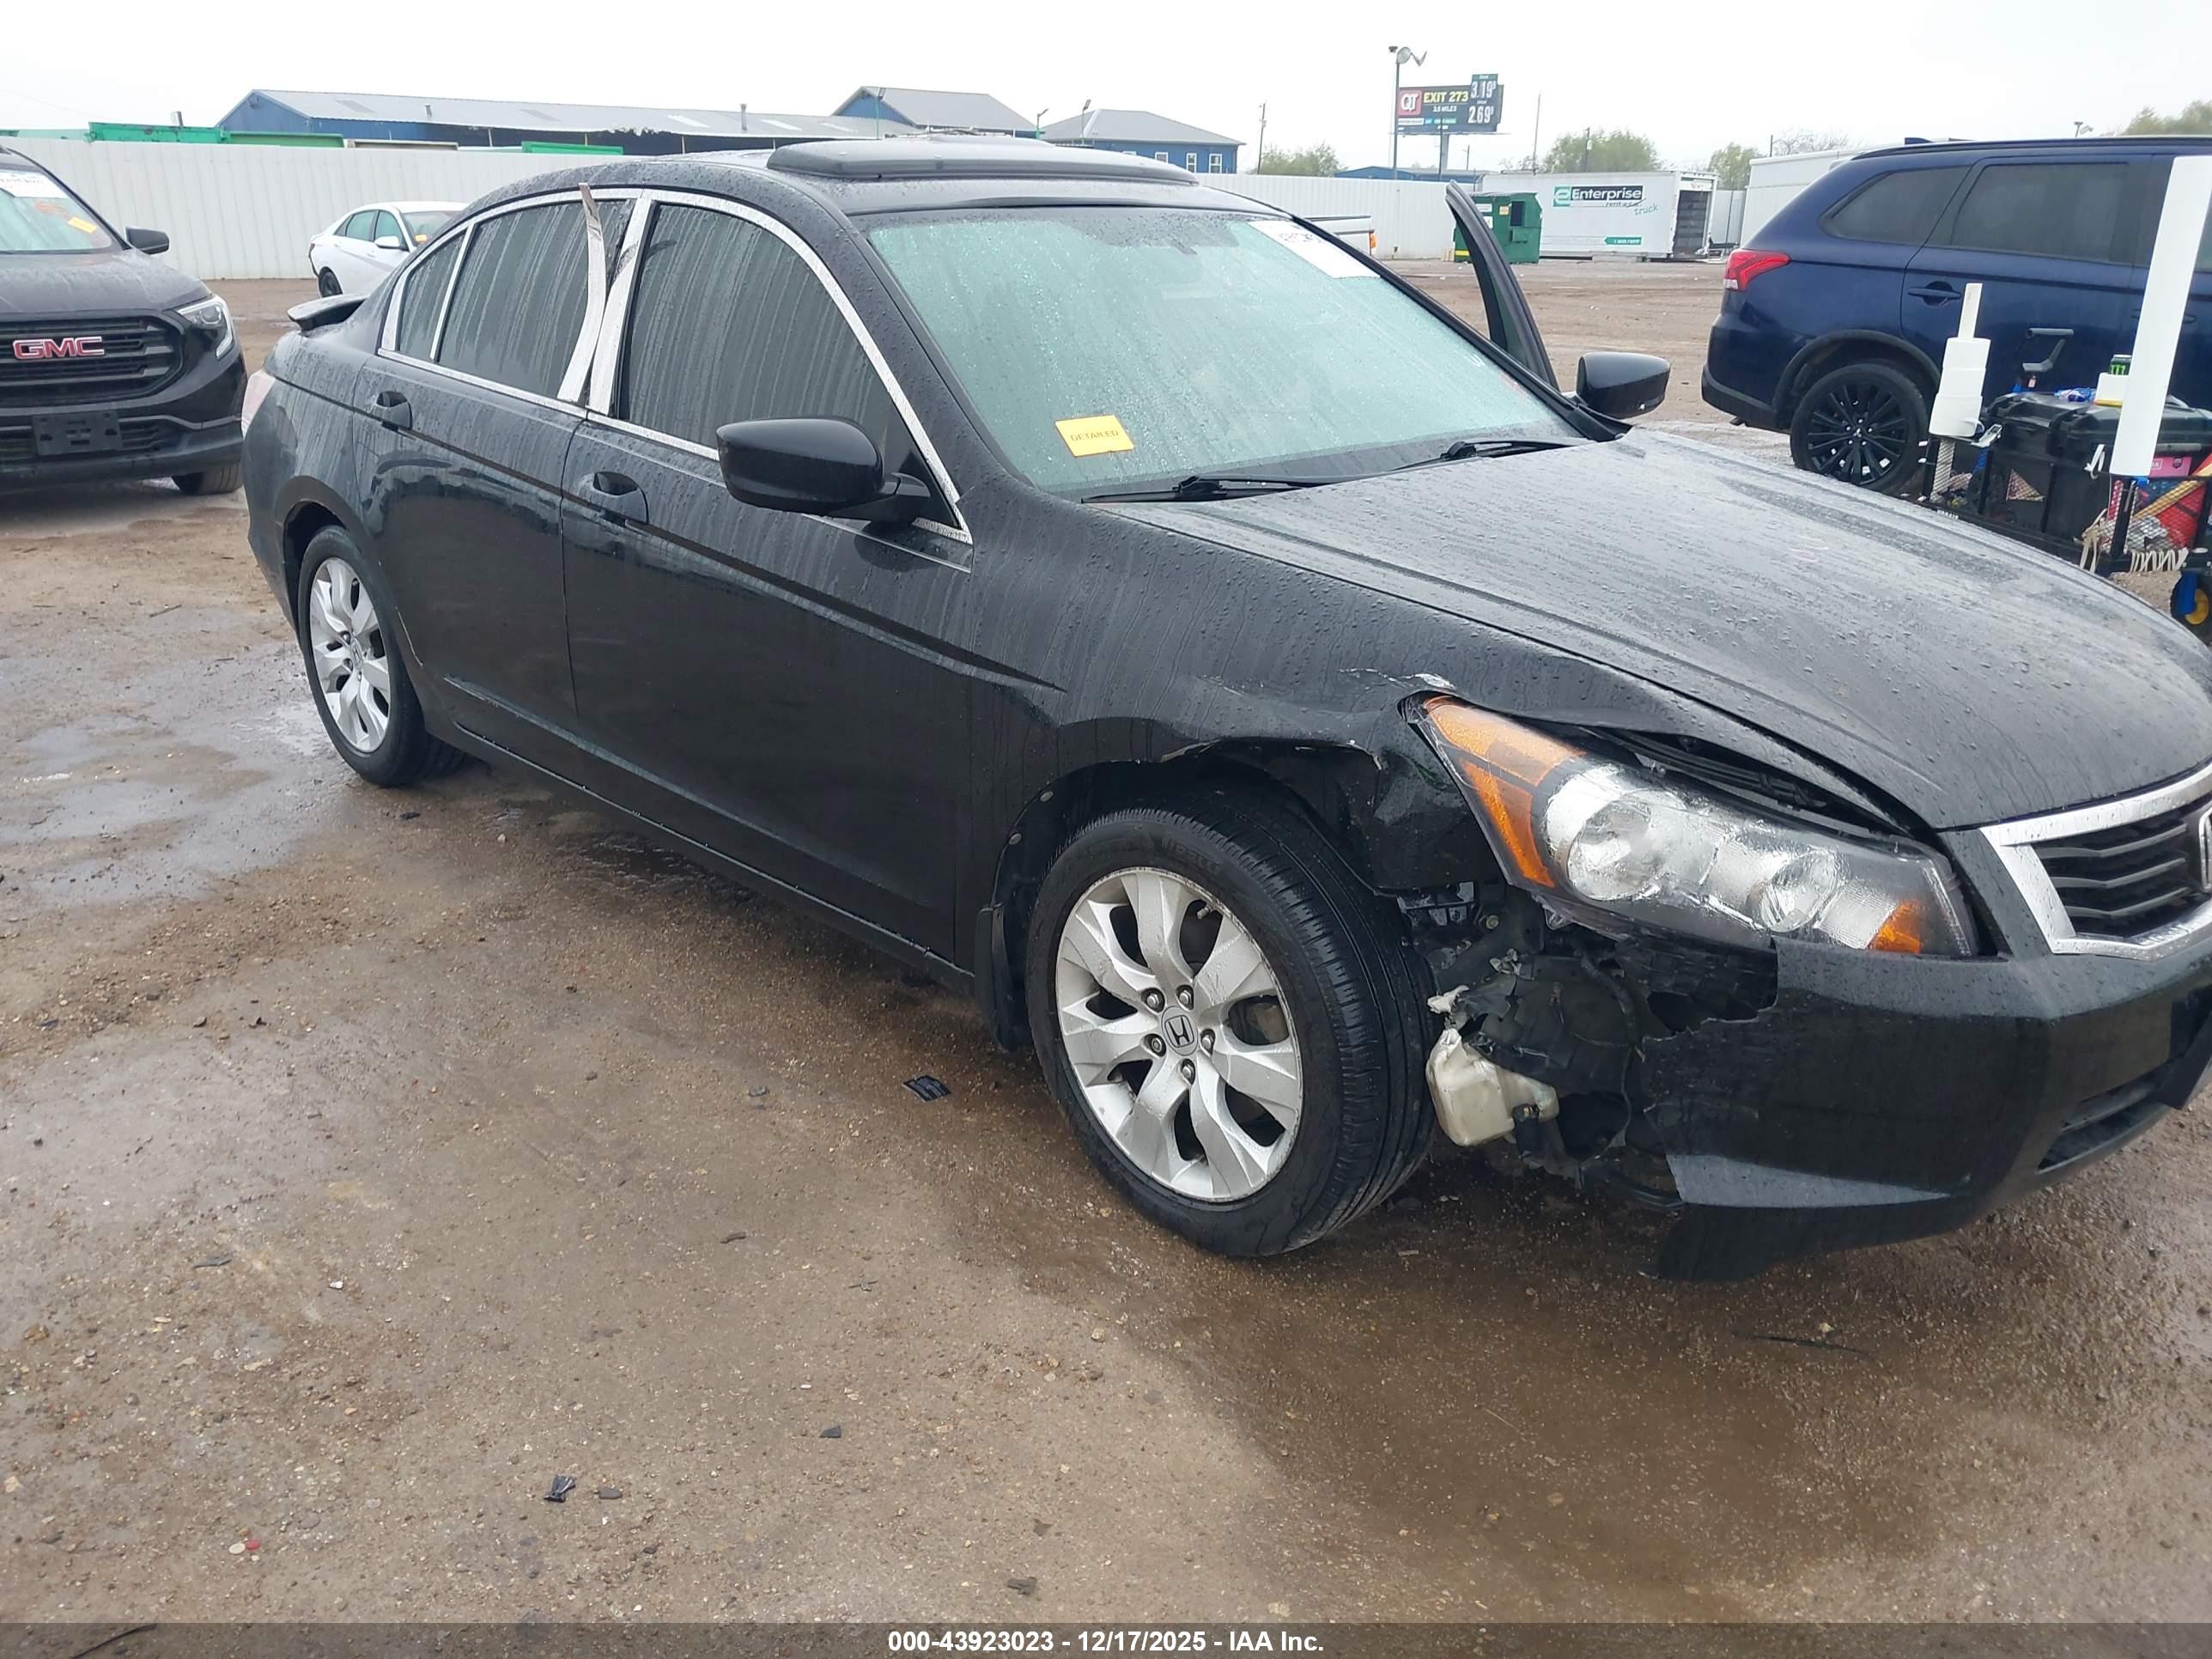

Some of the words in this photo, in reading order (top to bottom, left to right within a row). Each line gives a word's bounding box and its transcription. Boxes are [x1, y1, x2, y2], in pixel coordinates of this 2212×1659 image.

[1423, 91, 1447, 103] EXIT
[1449, 90, 1469, 103] 273
[1571, 187, 1642, 201] Enterprise
[1634, 203, 1659, 216] truck
[13, 336, 105, 359] GMC
[1070, 430, 1119, 441] DETAILED
